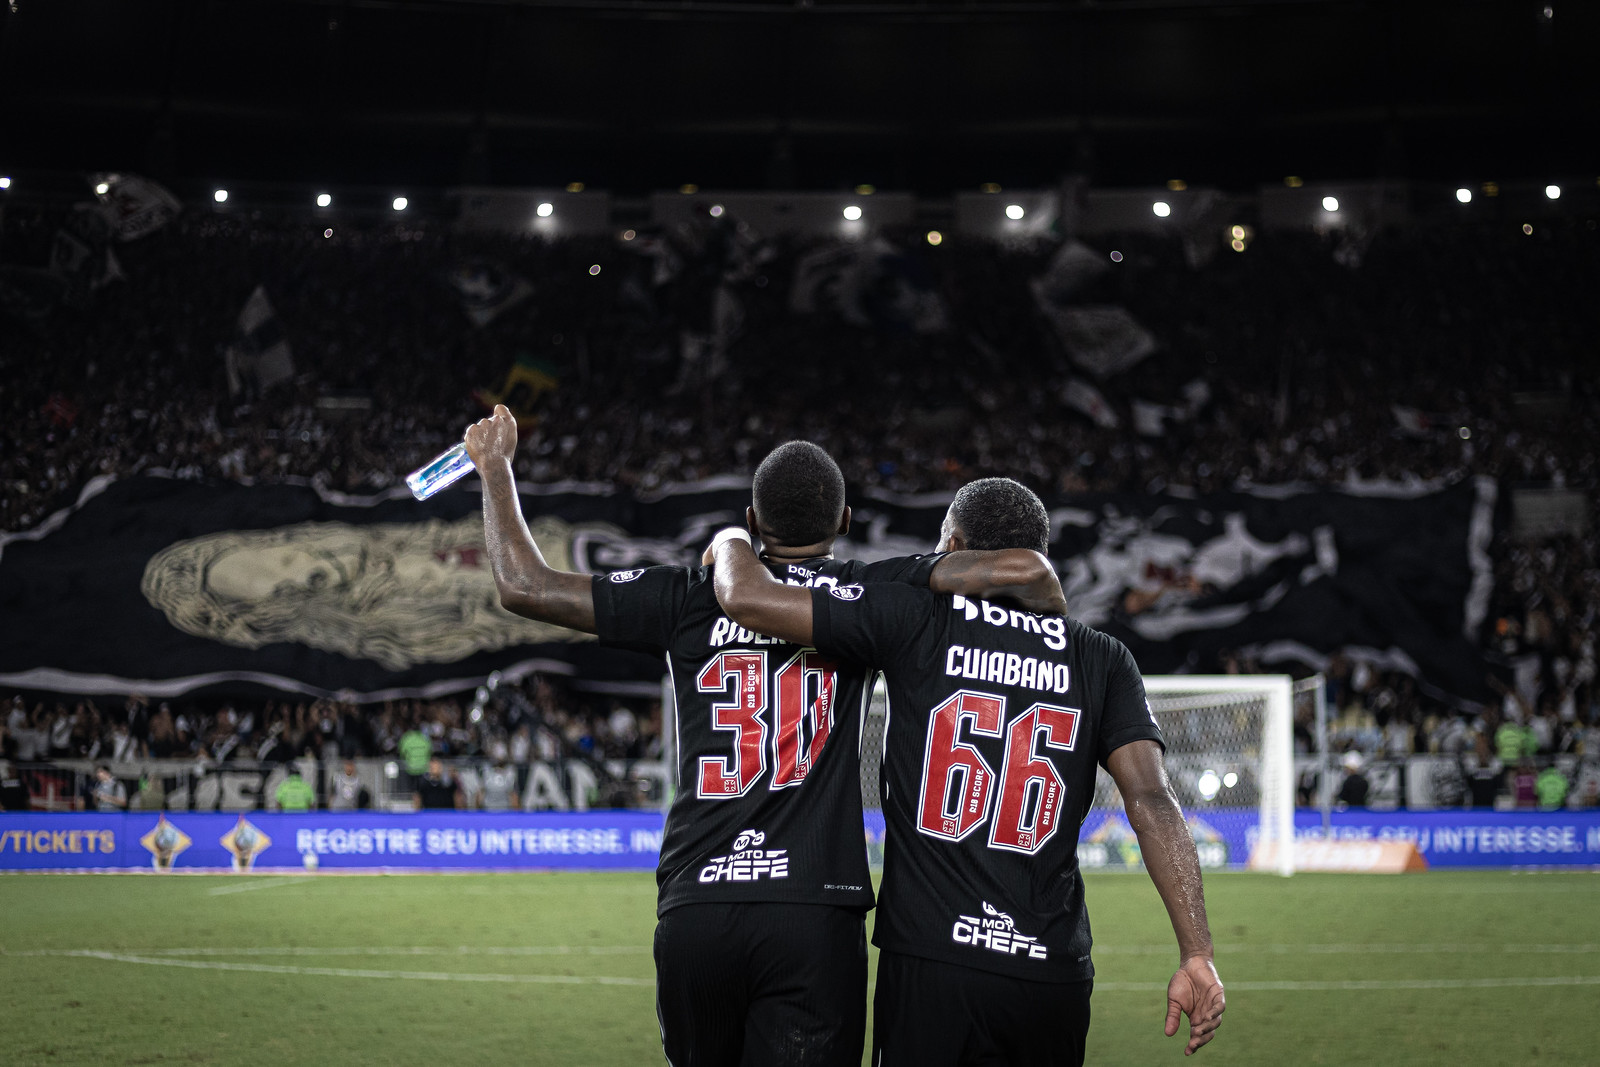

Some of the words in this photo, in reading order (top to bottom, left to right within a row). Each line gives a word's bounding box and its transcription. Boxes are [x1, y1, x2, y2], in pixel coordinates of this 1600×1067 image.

[981, 599, 1068, 651] bmg
[747, 663, 756, 693] SCORE
[945, 645, 1070, 694] CUIABANO
[696, 649, 838, 800] 30
[916, 689, 1082, 855] 66
[972, 769, 985, 798] SCORE
[1045, 781, 1057, 810] SCORE
[296, 828, 421, 854] REGISTRE
[426, 828, 478, 855] SEU
[727, 849, 764, 862] MOTO
[699, 857, 789, 883] CHEFE
